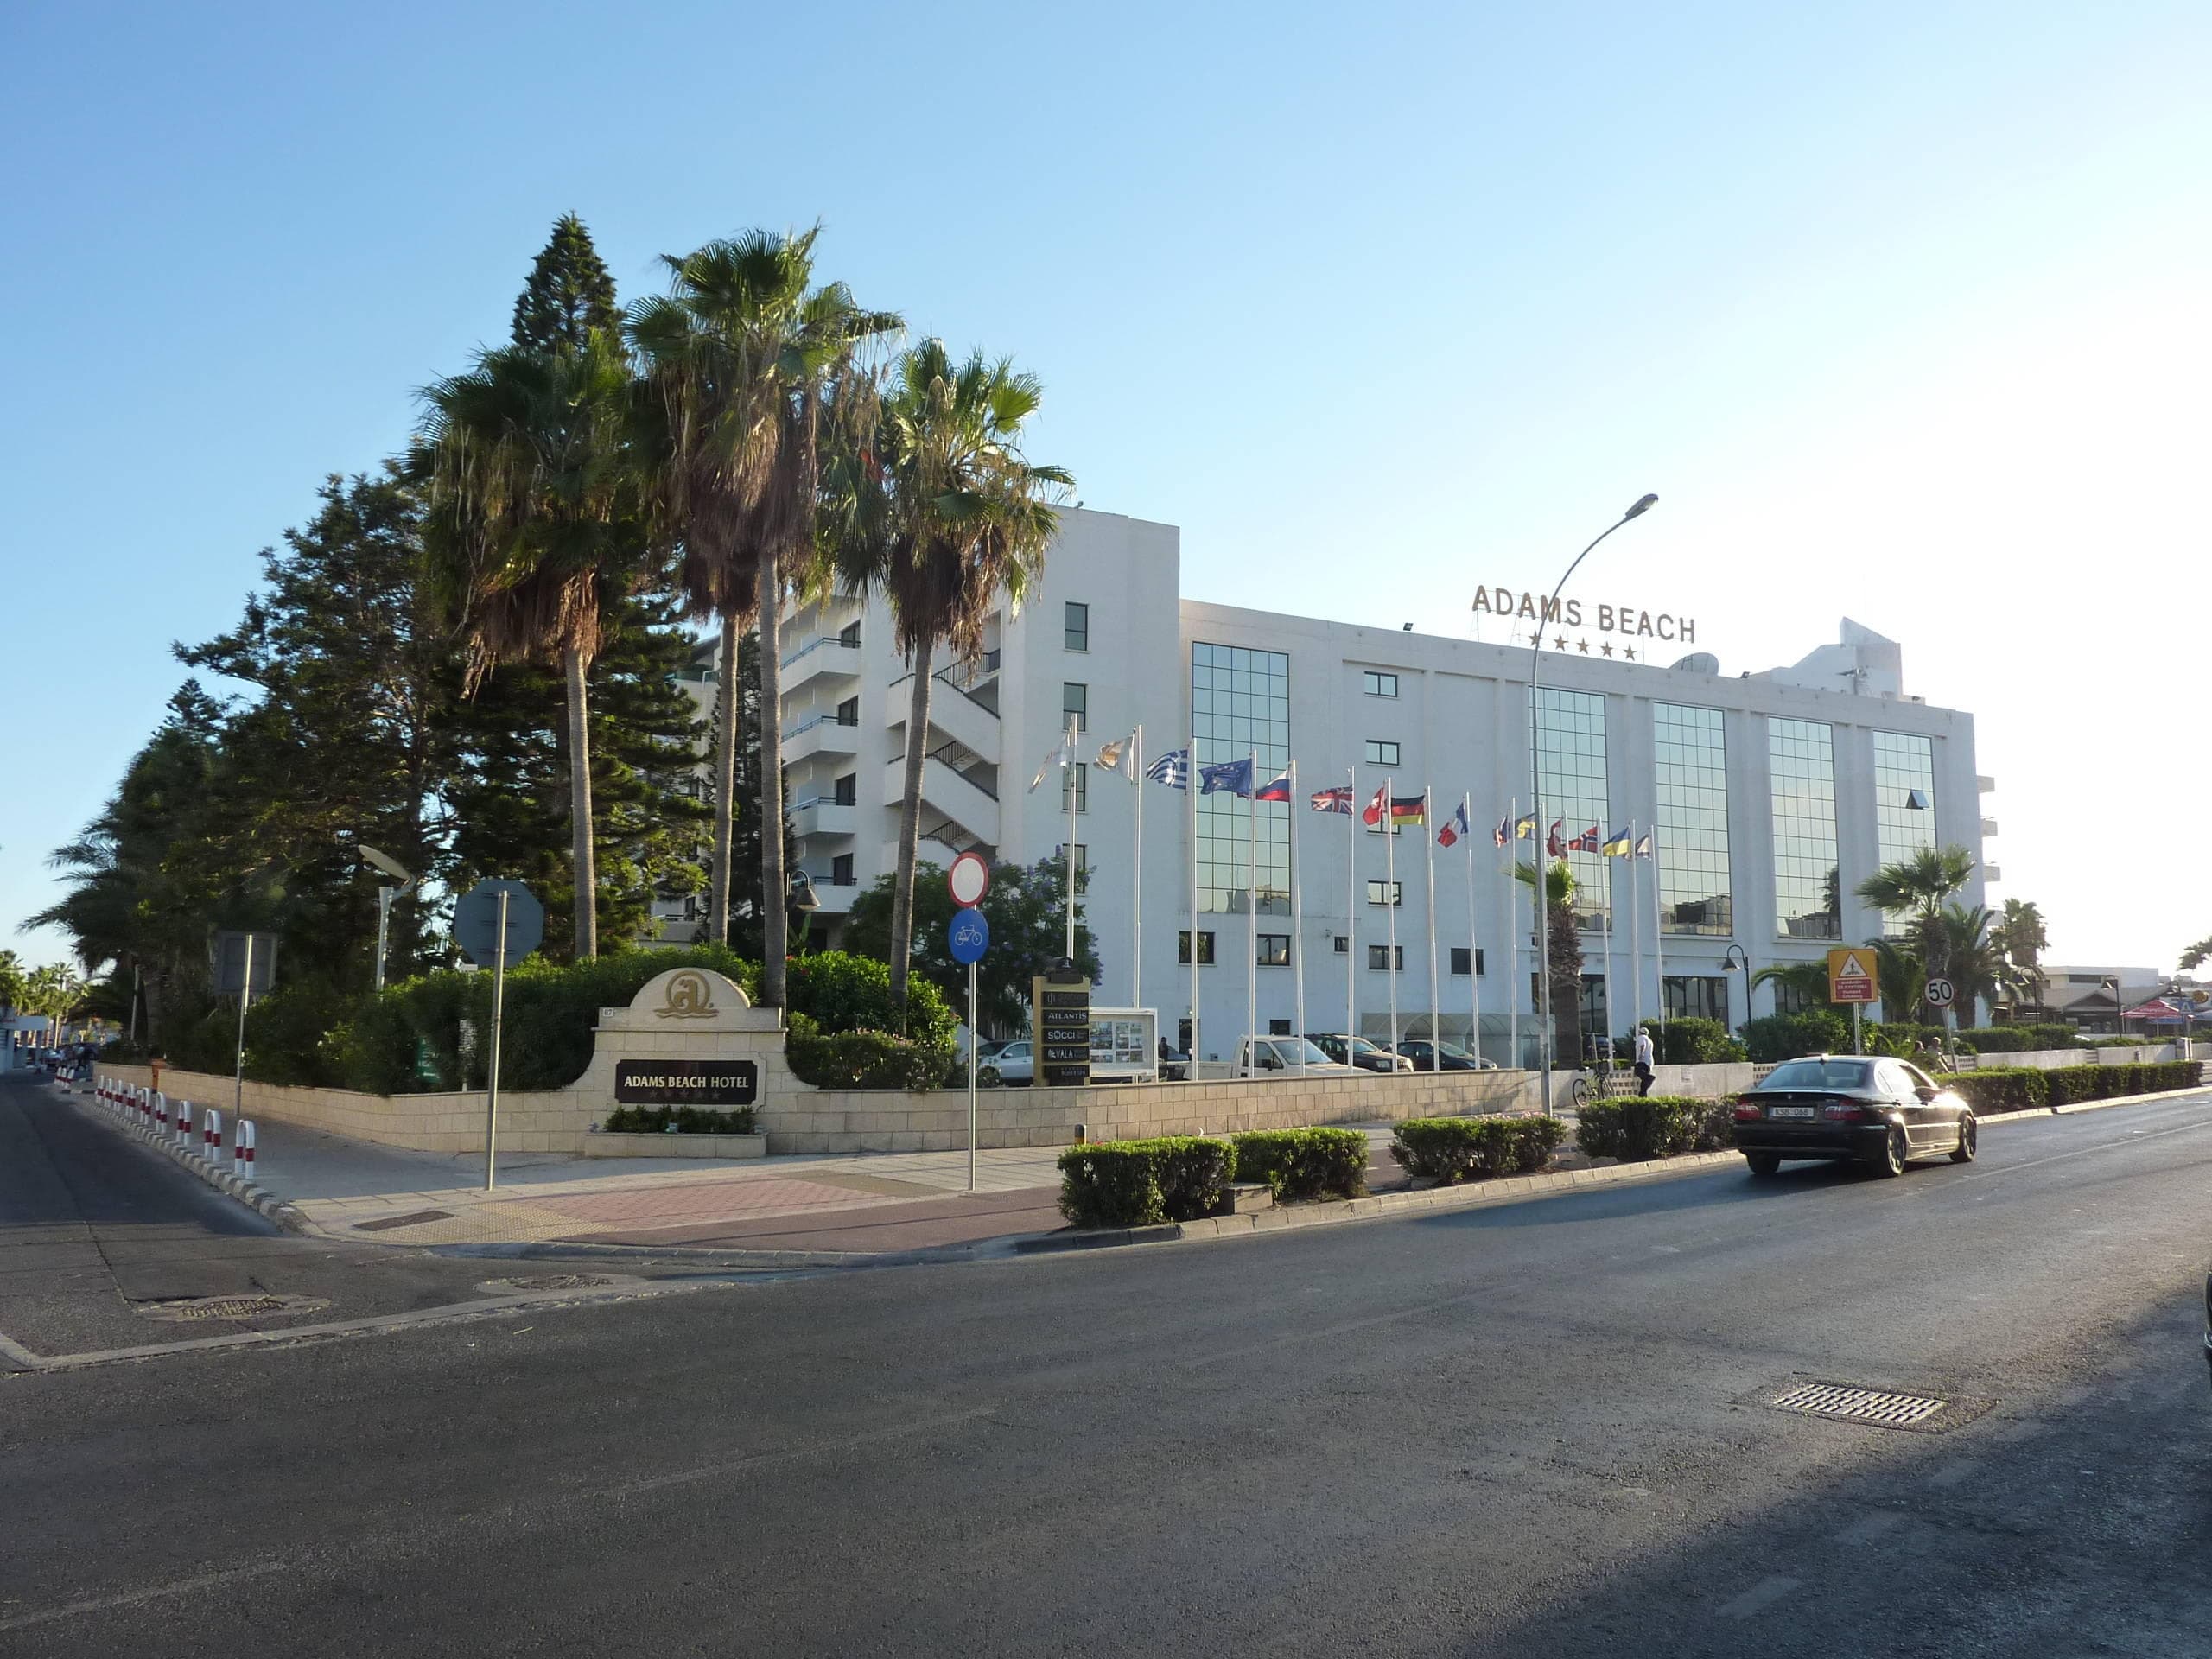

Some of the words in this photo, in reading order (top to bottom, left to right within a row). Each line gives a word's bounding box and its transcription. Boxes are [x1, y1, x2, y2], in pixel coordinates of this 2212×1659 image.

[1471, 585, 1582, 627] ADAMS
[1599, 603, 1695, 644] BEACH
[1929, 982, 1952, 1002] 50
[1047, 1012, 1087, 1020] ATLANTIS
[624, 1076, 665, 1088] ADAMS
[668, 1076, 706, 1089] BEACH
[710, 1077, 749, 1089] HOTEL
